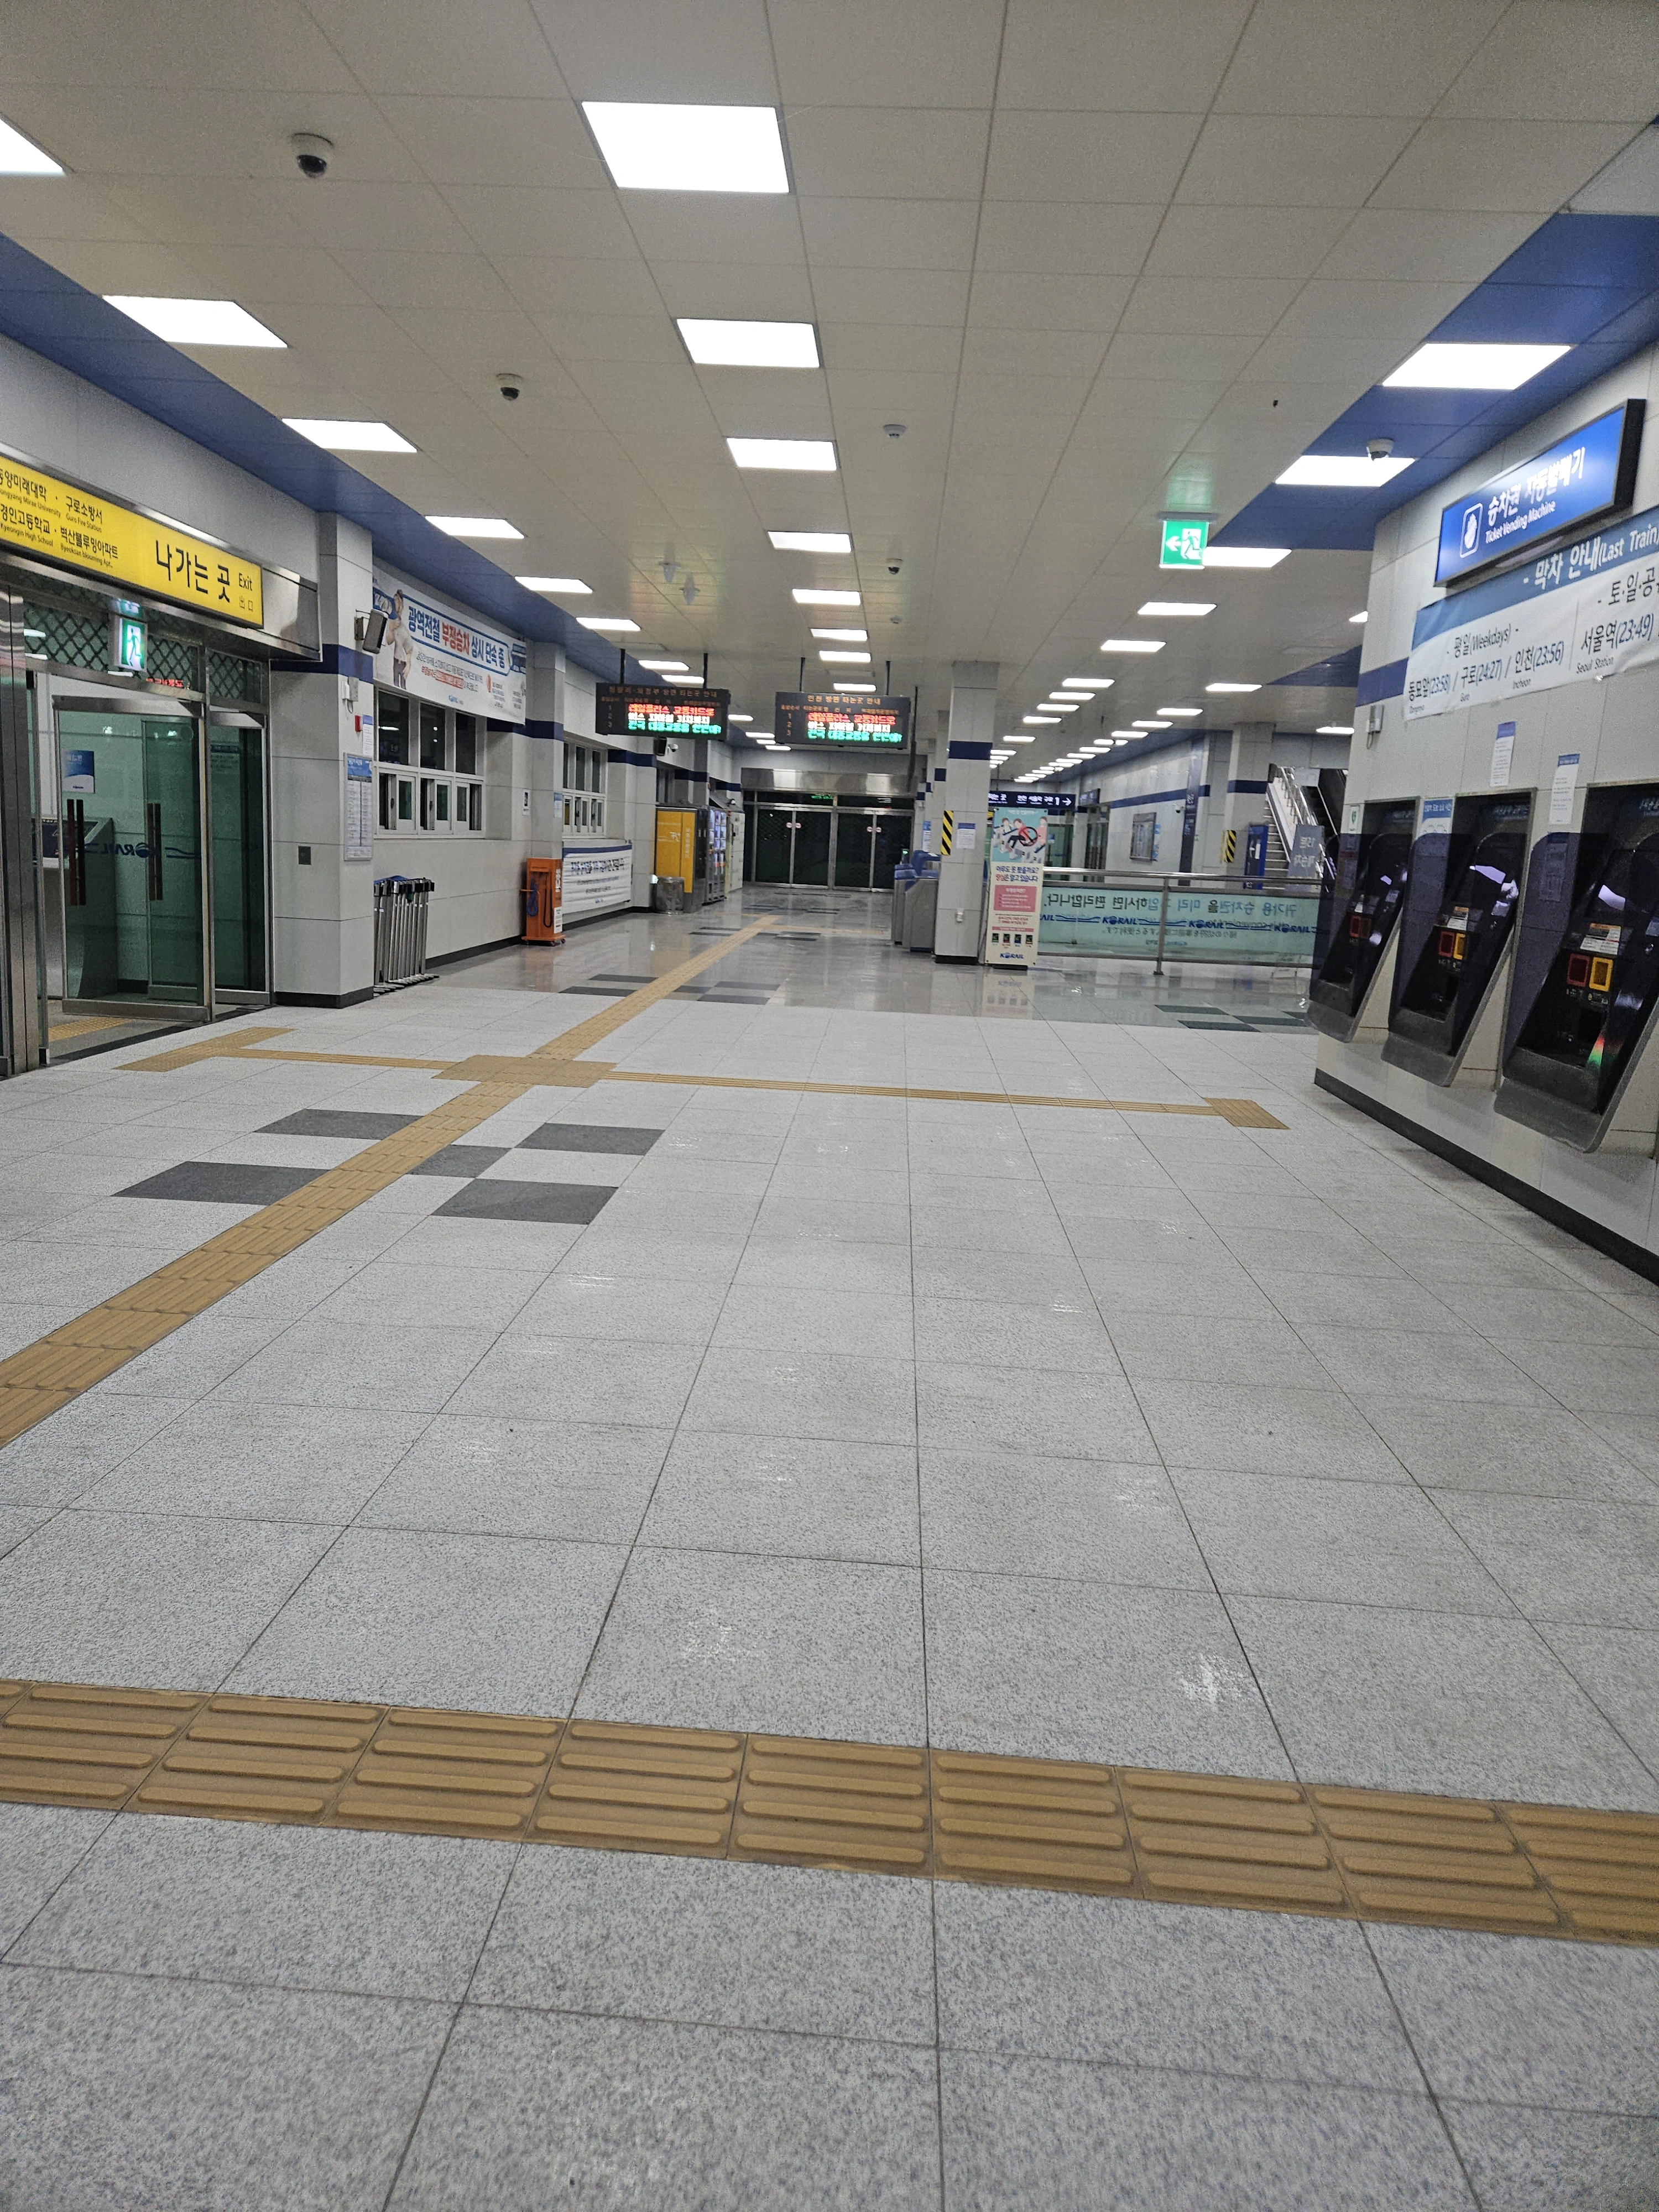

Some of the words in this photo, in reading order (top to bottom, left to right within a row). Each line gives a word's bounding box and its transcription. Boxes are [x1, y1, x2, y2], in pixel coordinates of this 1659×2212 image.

[0, 488, 22, 504] ongyang
[37, 502, 61, 517] University
[66, 495, 102, 524] 구로소방서
[1488, 483, 1521, 526] 승차권
[1, 504, 50, 534] 경인고등학교
[60, 526, 118, 559] 벽산블루밍아파트
[38, 534, 54, 546] School
[1485, 527, 1503, 544] Ticket
[1503, 514, 1528, 535] Vending
[1528, 500, 1556, 524] Machine
[155, 540, 208, 594] 나가는
[217, 564, 230, 603] 곳
[238, 572, 253, 591] Exit
[1535, 552, 1564, 589] 막차
[408, 606, 440, 643] 광역전철
[442, 622, 469, 655] 부정승차
[472, 636, 484, 661] 상시
[486, 642, 498, 666] 단속
[498, 647, 505, 669] 중
[1102, 916, 1138, 925] KORAIL
